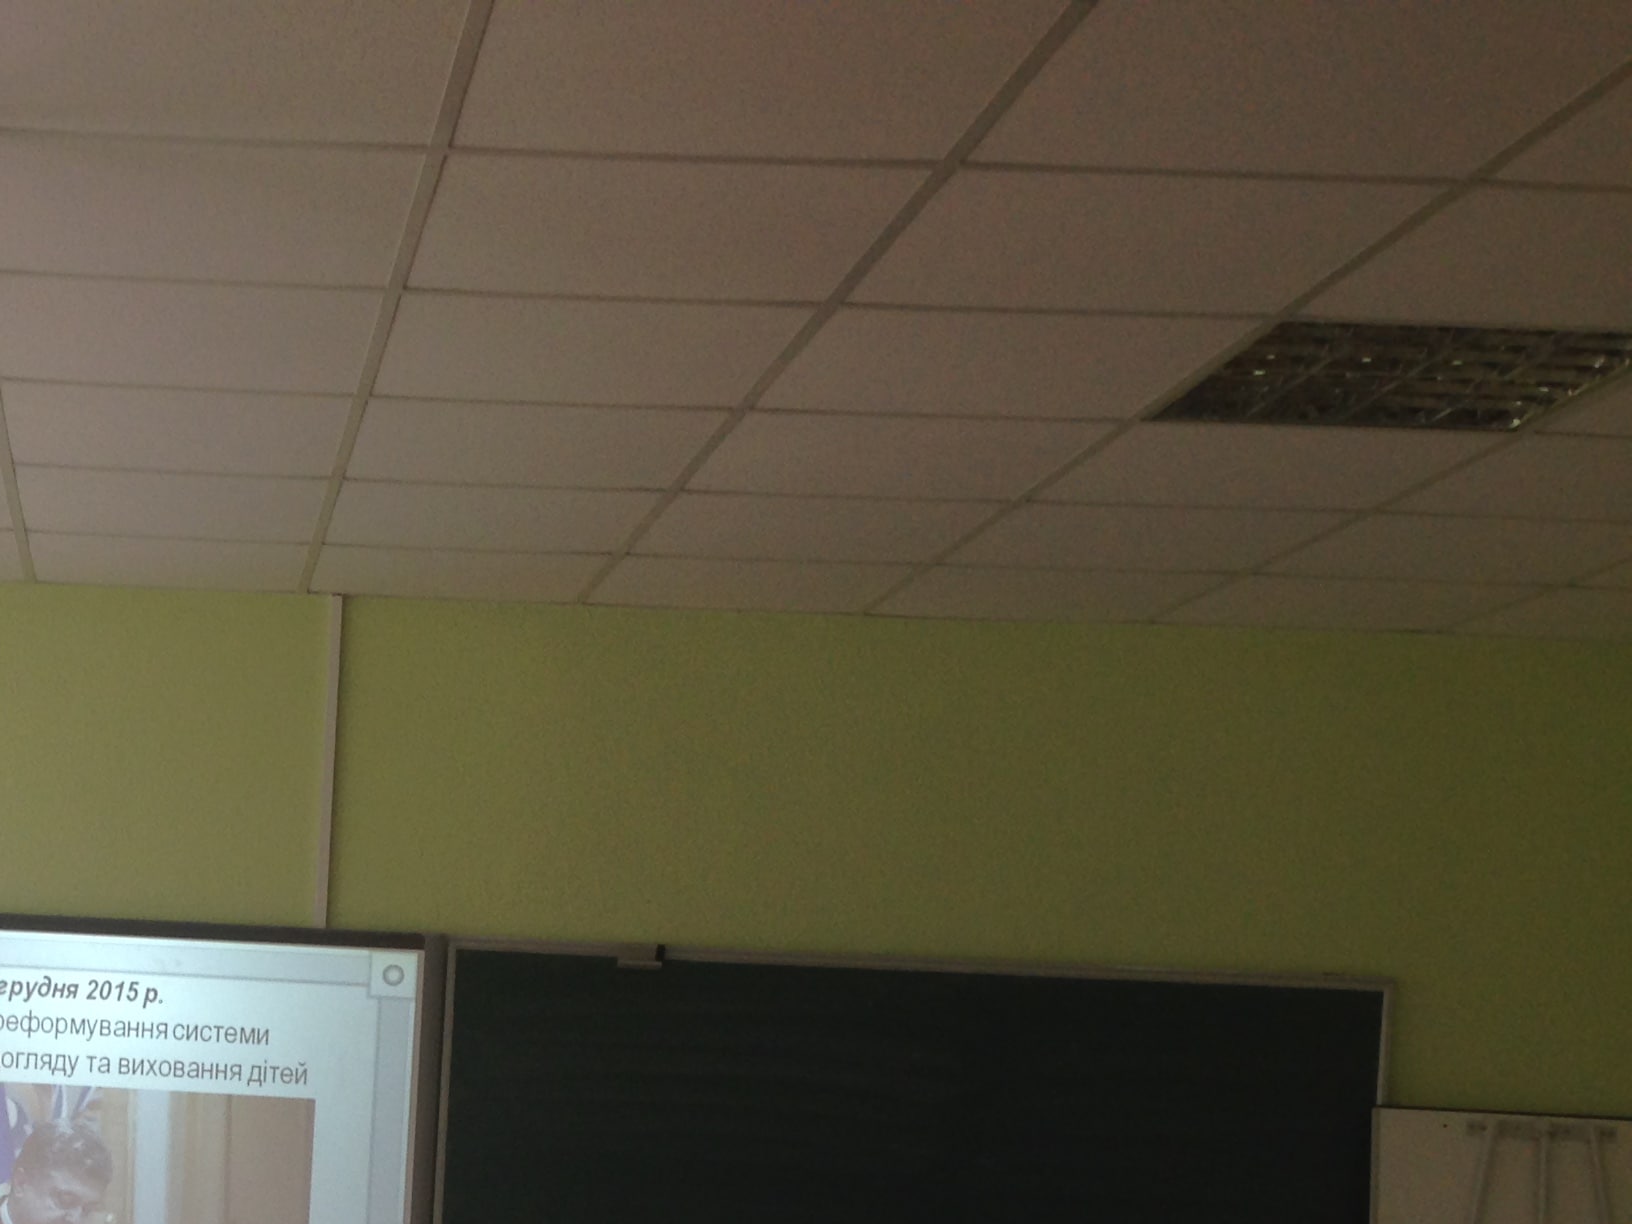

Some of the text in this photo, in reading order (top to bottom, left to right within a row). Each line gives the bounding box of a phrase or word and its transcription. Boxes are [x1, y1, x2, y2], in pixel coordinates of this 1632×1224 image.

[86, 979, 139, 1002] 2015
[143, 986, 163, 1009] р.
[172, 1022, 270, 1045] системи
[86, 1054, 111, 1074] та
[118, 1057, 242, 1082] виховання
[247, 1060, 308, 1087] дітей
